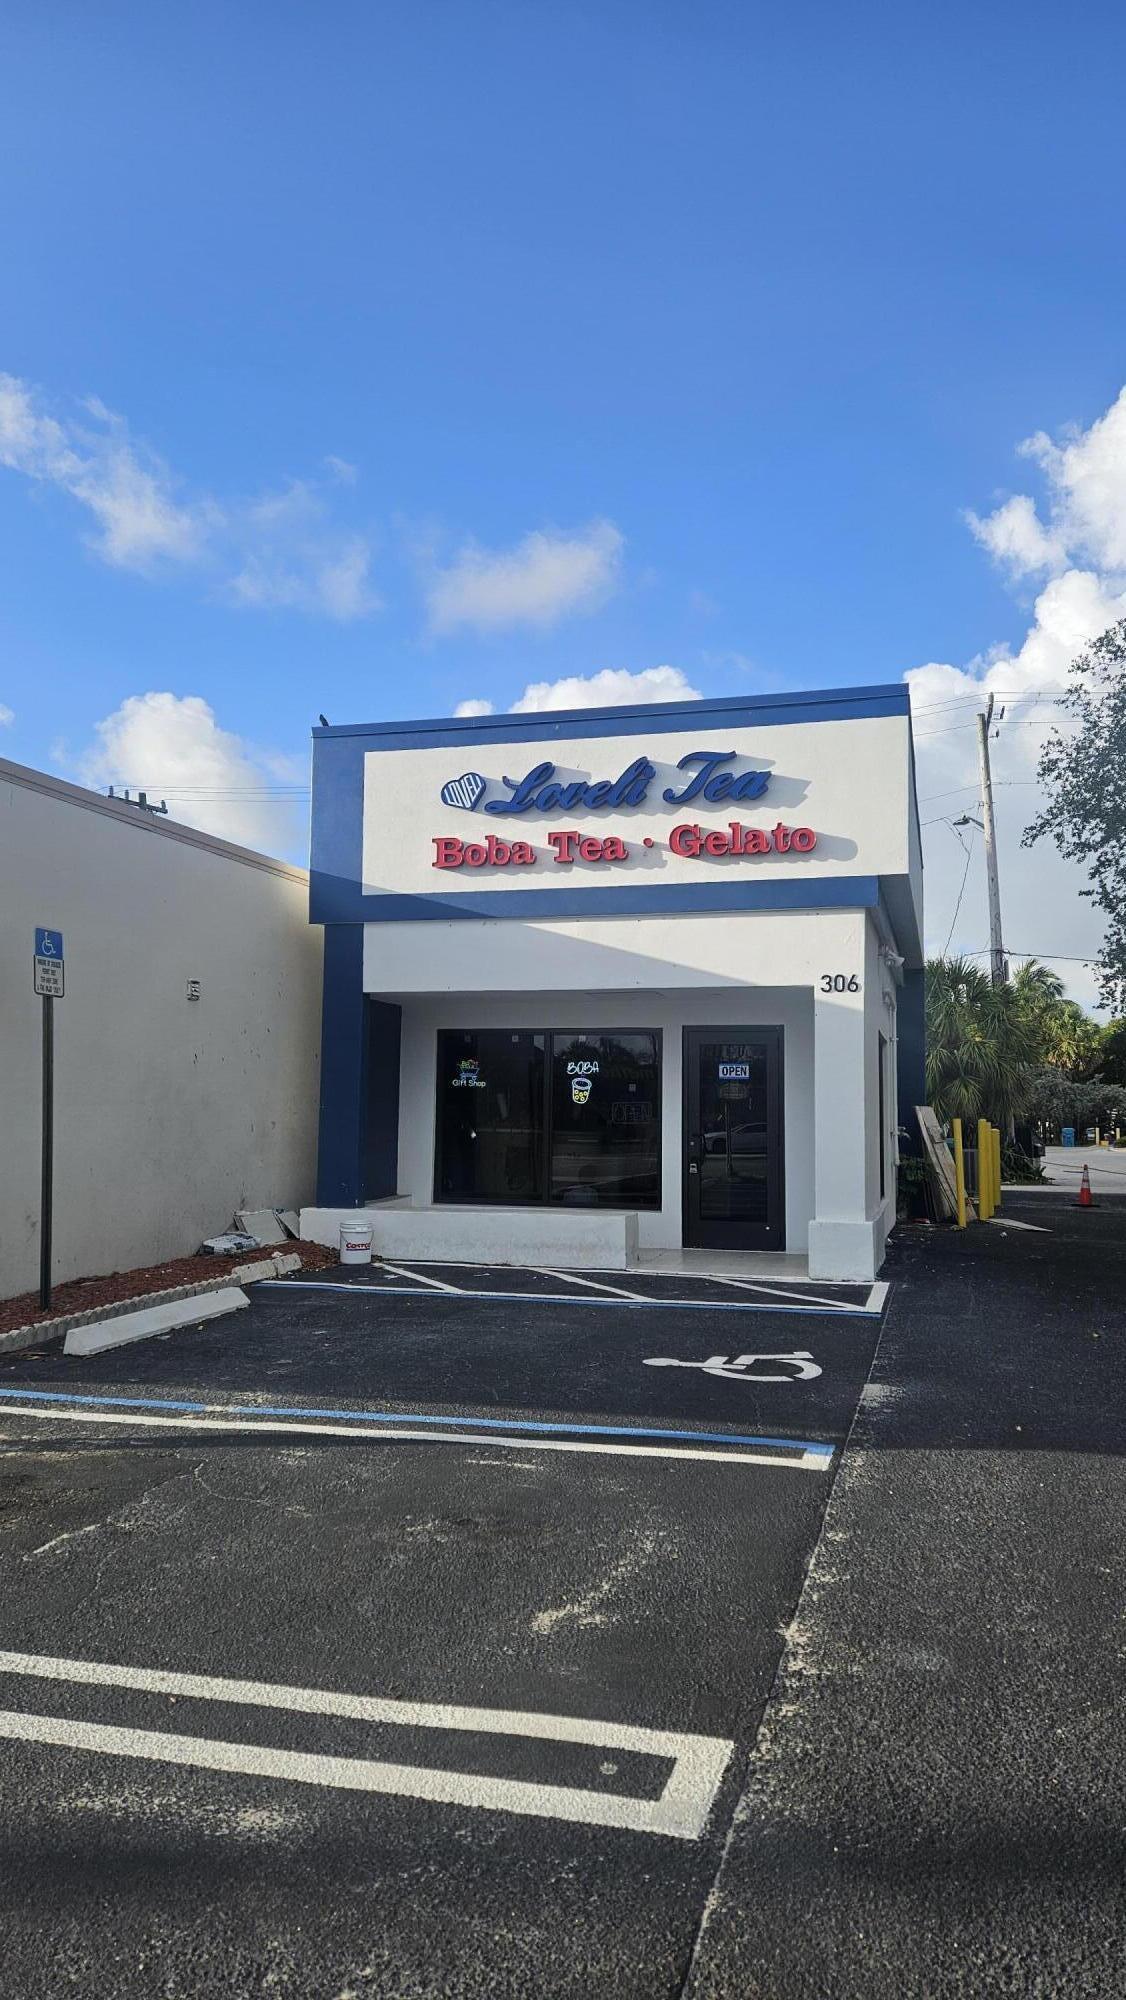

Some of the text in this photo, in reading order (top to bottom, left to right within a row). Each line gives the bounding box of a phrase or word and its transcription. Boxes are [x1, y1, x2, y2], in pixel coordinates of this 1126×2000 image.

[484, 751, 772, 814] Loveli Tea
[432, 835, 537, 868] Boba
[548, 831, 629, 863] Tea
[669, 822, 817, 858] Gelato
[821, 974, 859, 993] 306
[567, 1061, 599, 1074] BOBA
[722, 1066, 747, 1076] OPEN
[452, 1079, 487, 1088] Gift Shop
